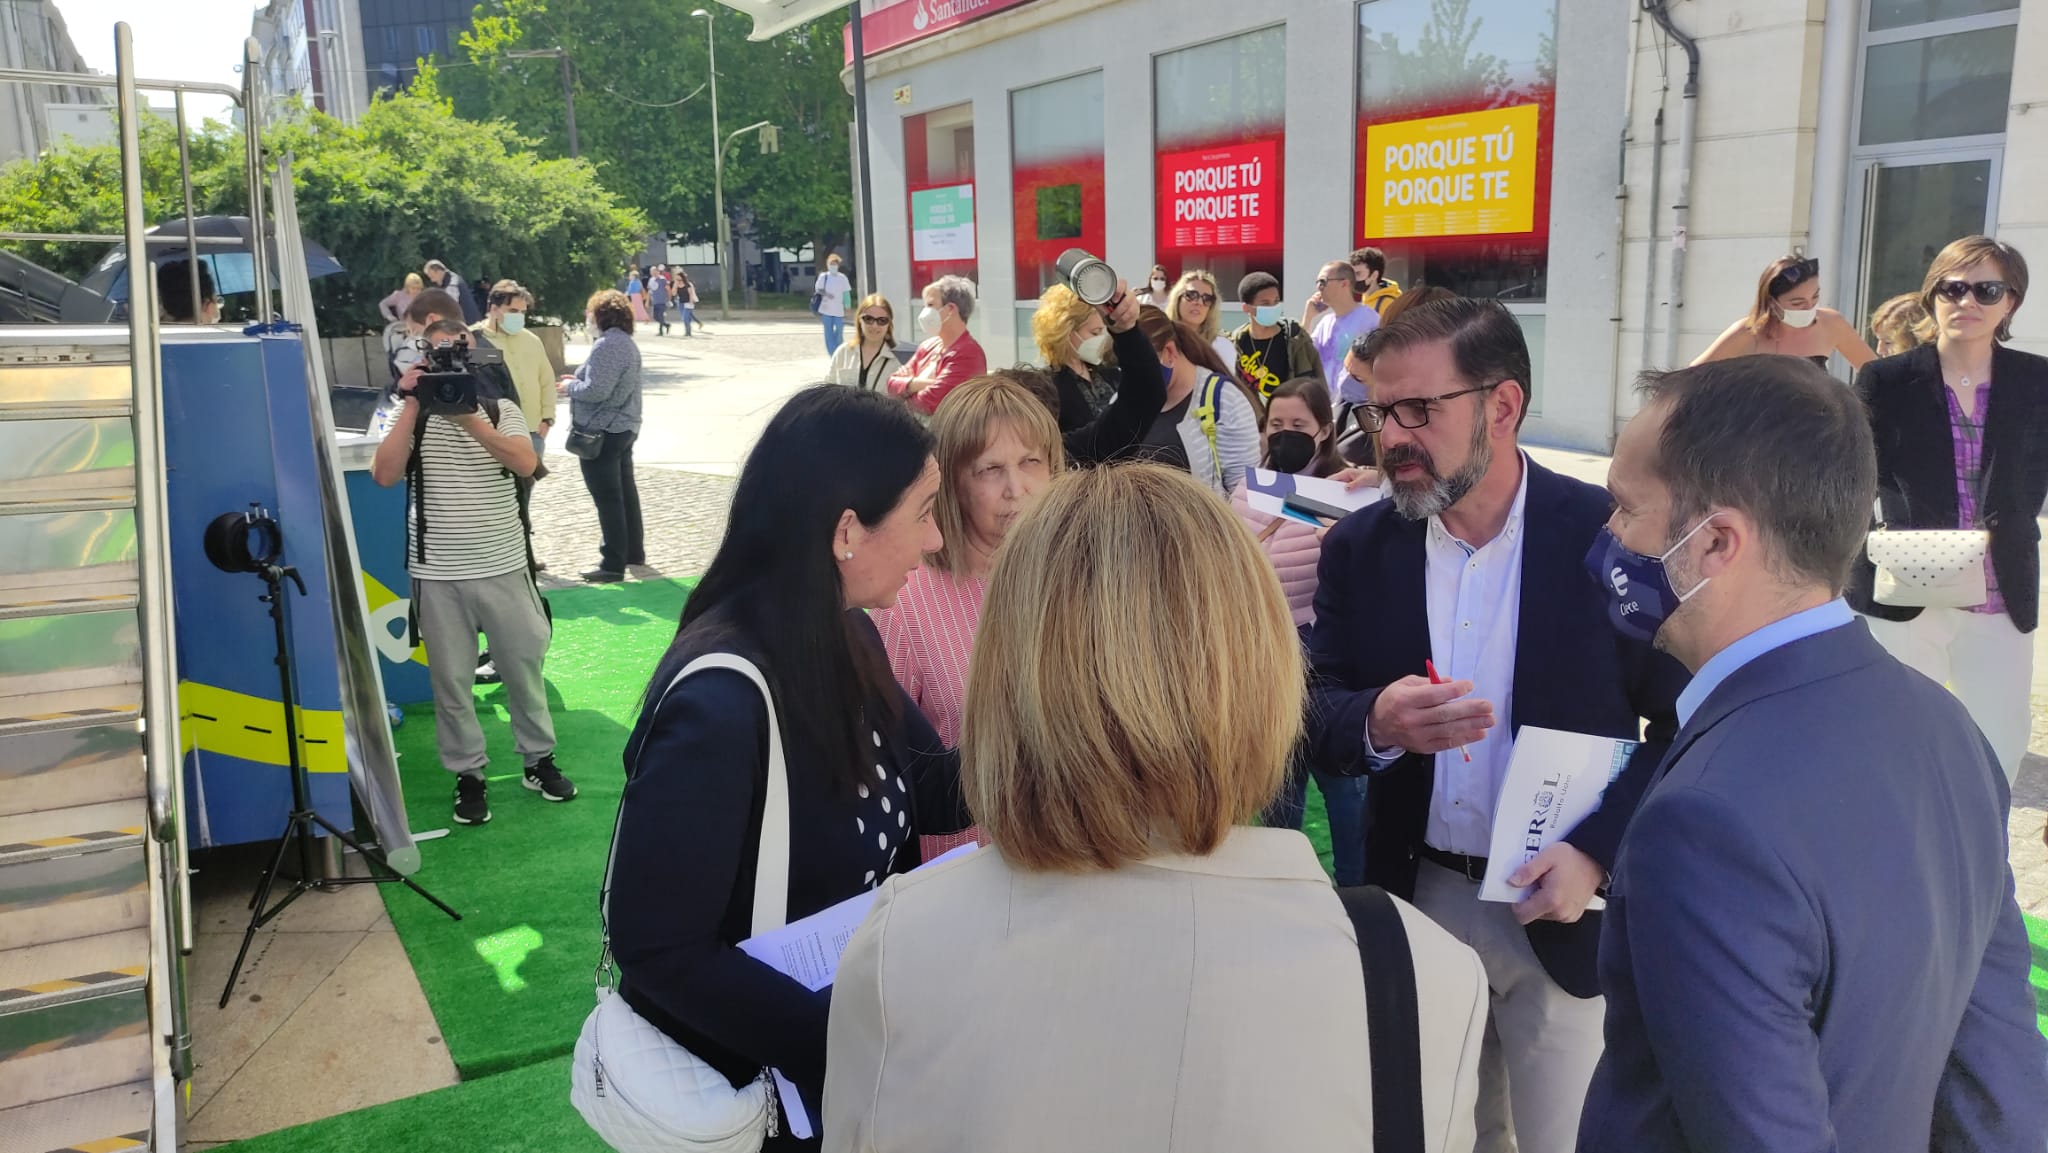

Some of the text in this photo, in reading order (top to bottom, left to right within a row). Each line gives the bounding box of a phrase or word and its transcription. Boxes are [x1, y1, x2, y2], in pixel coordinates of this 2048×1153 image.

[1383, 124, 1514, 173] PORQUE TÚ
[1175, 156, 1261, 194] PORQUE TÚ
[1383, 170, 1510, 207] PORQUE TE
[1175, 193, 1259, 222] PORQUE TE
